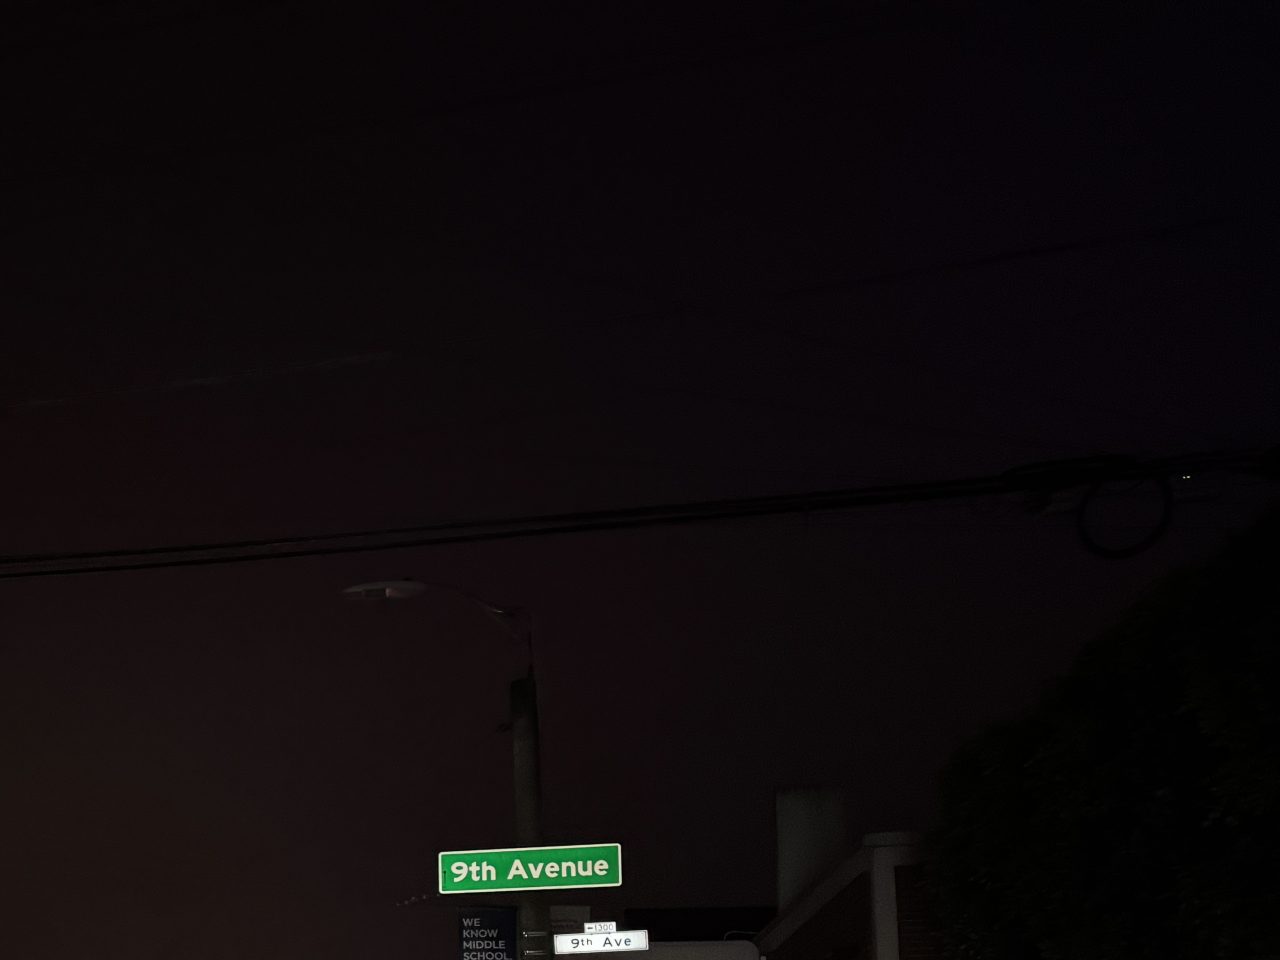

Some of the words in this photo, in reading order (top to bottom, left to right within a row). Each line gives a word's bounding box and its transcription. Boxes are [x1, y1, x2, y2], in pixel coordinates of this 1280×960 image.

[450, 861, 497, 883] 9th
[506, 858, 610, 880] Avenue
[462, 918, 481, 927] WE
[594, 923, 614, 931] 1300
[463, 929, 499, 938] KNOW
[463, 940, 506, 950] MIDDLE
[570, 938, 593, 949] 9th
[602, 937, 632, 947] Ave
[463, 952, 513, 960] SCHOOL.
